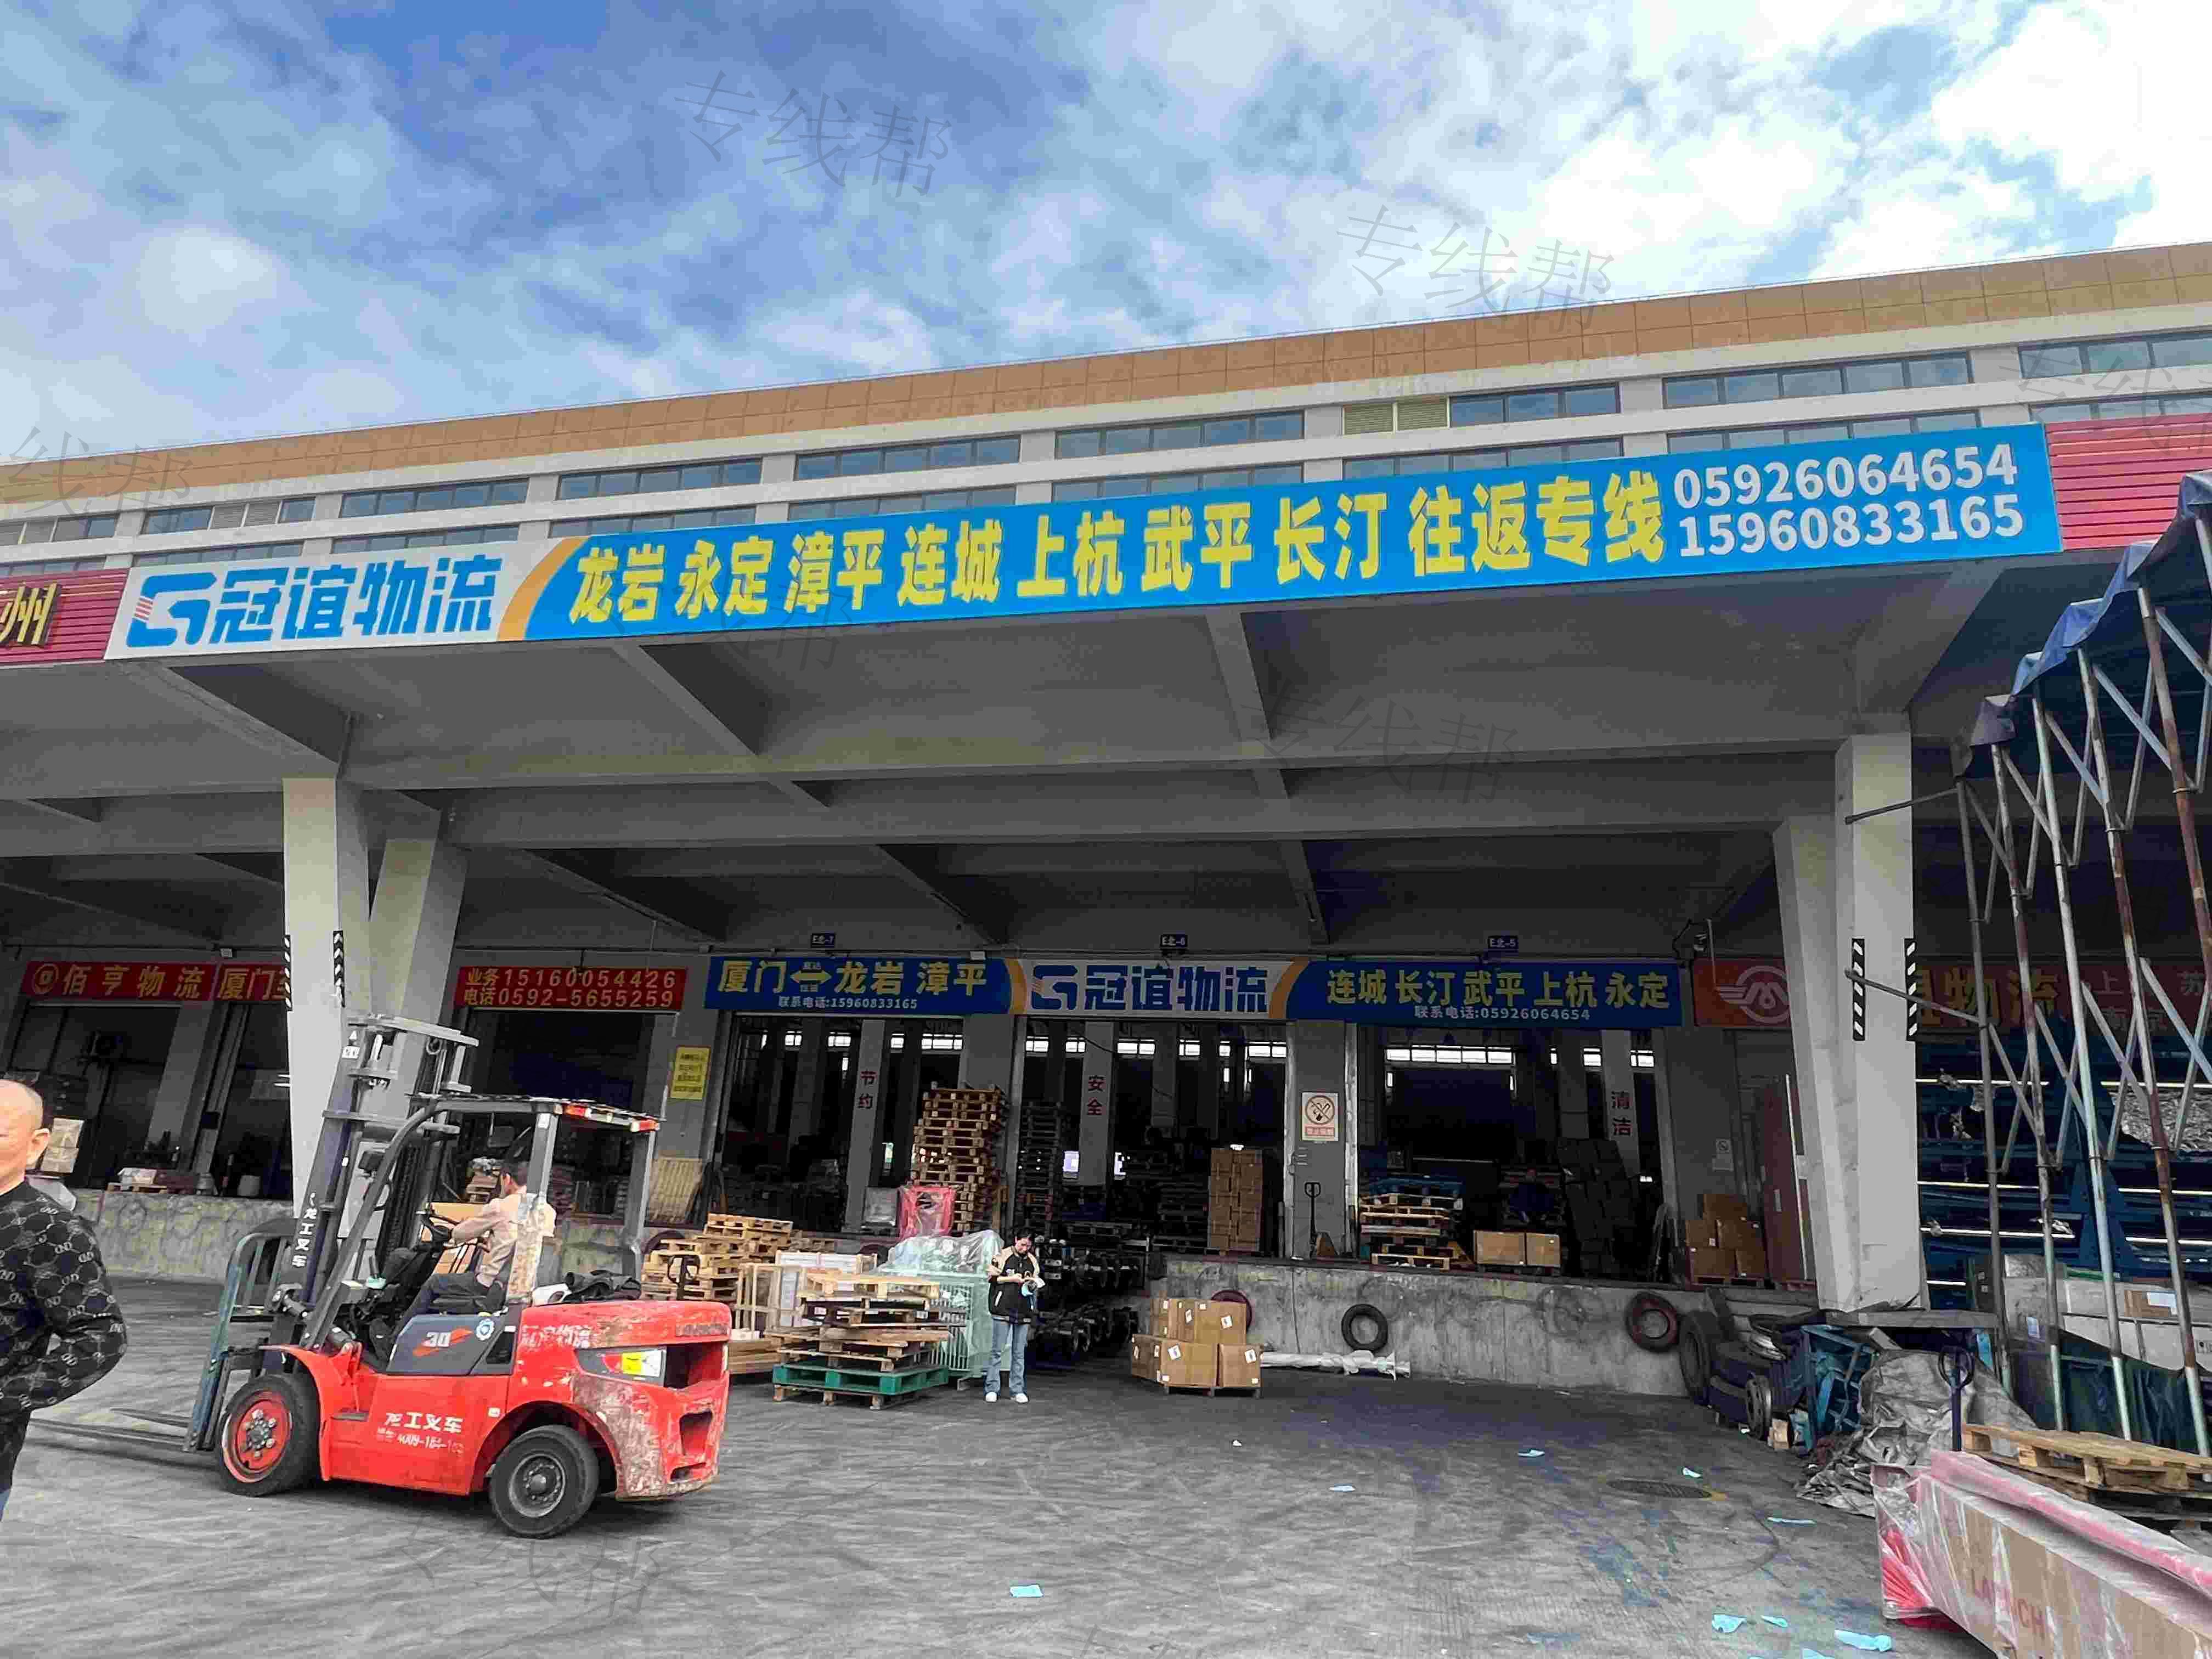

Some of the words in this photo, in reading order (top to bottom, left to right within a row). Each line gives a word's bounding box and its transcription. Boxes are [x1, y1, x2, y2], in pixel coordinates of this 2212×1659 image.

[1672, 442, 2018, 511] 05926064654
[569, 543, 665, 625] 龙岩
[675, 536, 775, 620] 永定
[783, 528, 886, 613] 漳平
[896, 518, 1004, 607] 连城
[1017, 510, 1126, 597] 上杭
[1141, 503, 1253, 592] 武平
[1274, 491, 1387, 585] 长汀
[1408, 470, 1664, 578] 往返专线
[1679, 493, 2024, 557] 15960833165
[208, 554, 502, 644] 冠谊物流
[718, 960, 787, 993] 厦门
[833, 960, 904, 995] 龙岩
[916, 961, 987, 996] 漳平
[1084, 964, 1268, 1012] 冠谊物流
[1327, 969, 1387, 1005] 连城
[1395, 970, 1455, 1005] 长汀
[1463, 969, 1525, 1007] 武平
[1533, 970, 1598, 1008] 上杭
[1605, 972, 1670, 1009] 永定
[423, 1331, 452, 1347] 30
